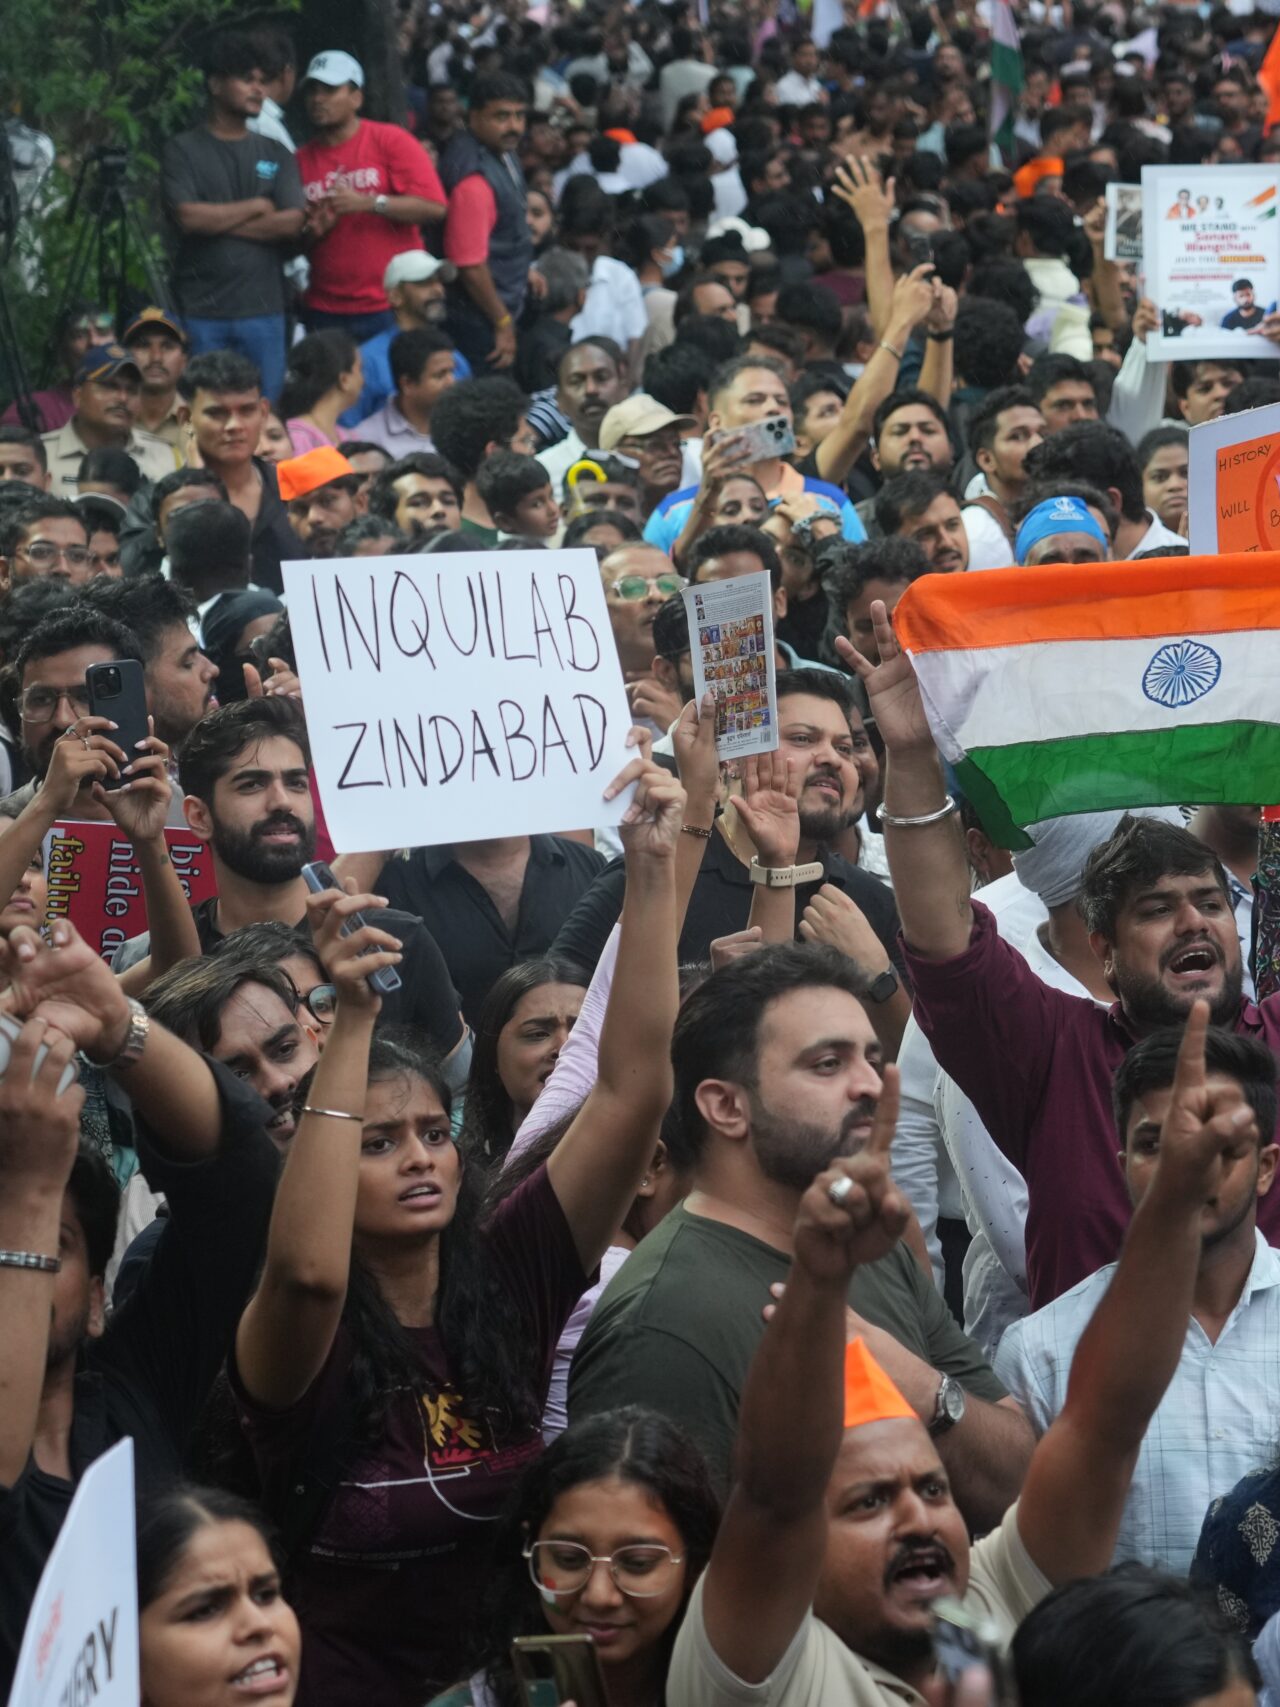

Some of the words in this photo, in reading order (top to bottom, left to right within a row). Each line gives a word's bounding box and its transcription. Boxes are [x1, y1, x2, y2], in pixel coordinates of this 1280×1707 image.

[1219, 444, 1272, 472] HISTORY
[1220, 500, 1250, 519] WILL
[1270, 509, 1280, 527] B
[311, 570, 601, 673] INQUILAB
[332, 694, 608, 790] ZINDABAD
